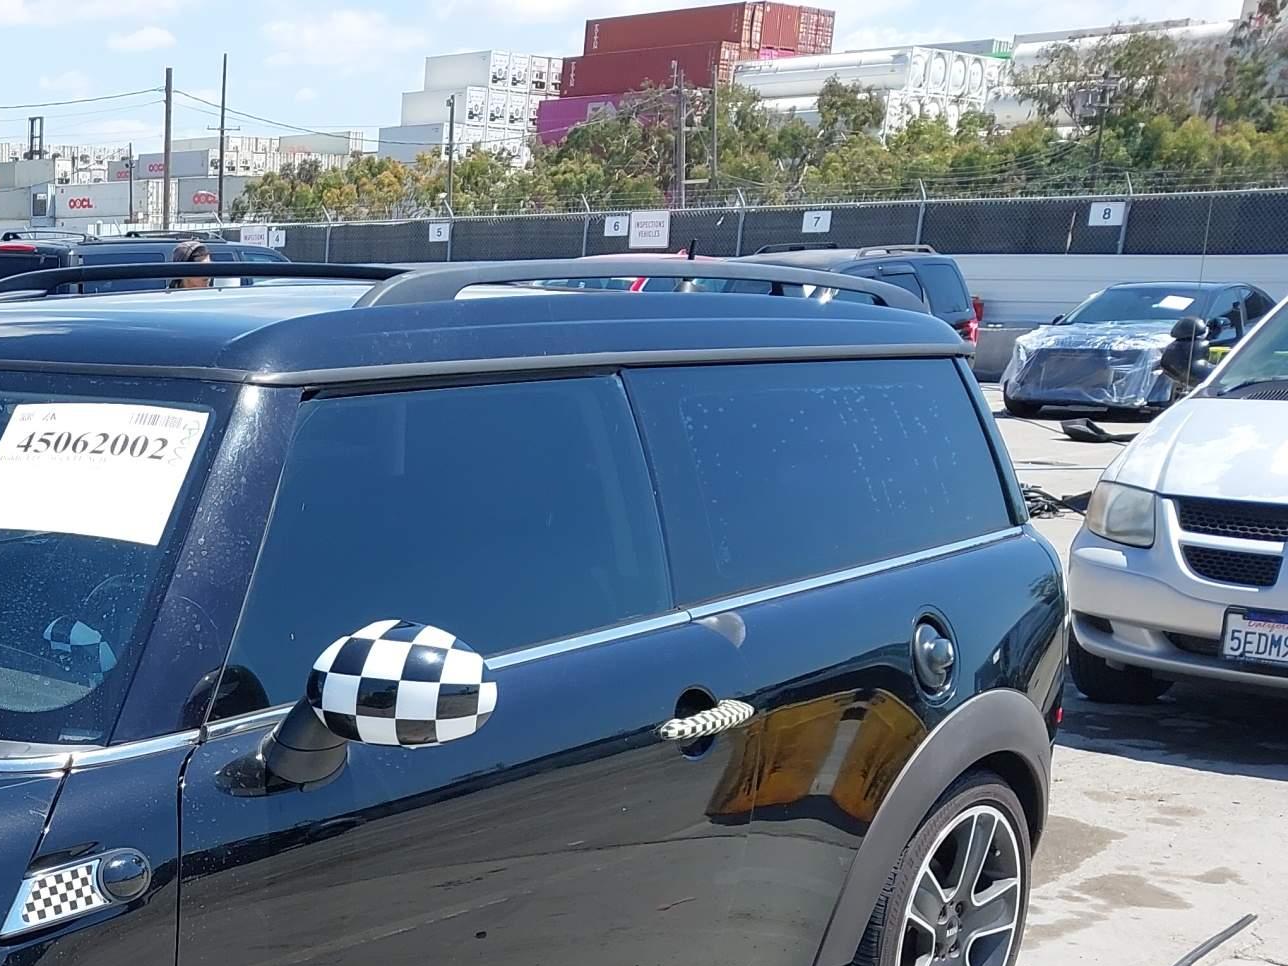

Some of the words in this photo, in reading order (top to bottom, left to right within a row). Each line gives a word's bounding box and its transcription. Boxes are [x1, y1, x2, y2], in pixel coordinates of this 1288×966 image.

[68, 197, 94, 209] OOCL
[1102, 207, 1112, 220] 8
[613, 221, 620, 232] 6
[813, 216, 822, 228] 7
[274, 234, 280, 243] 4
[436, 227, 443, 238] 5
[15, 431, 169, 461] 45062002
